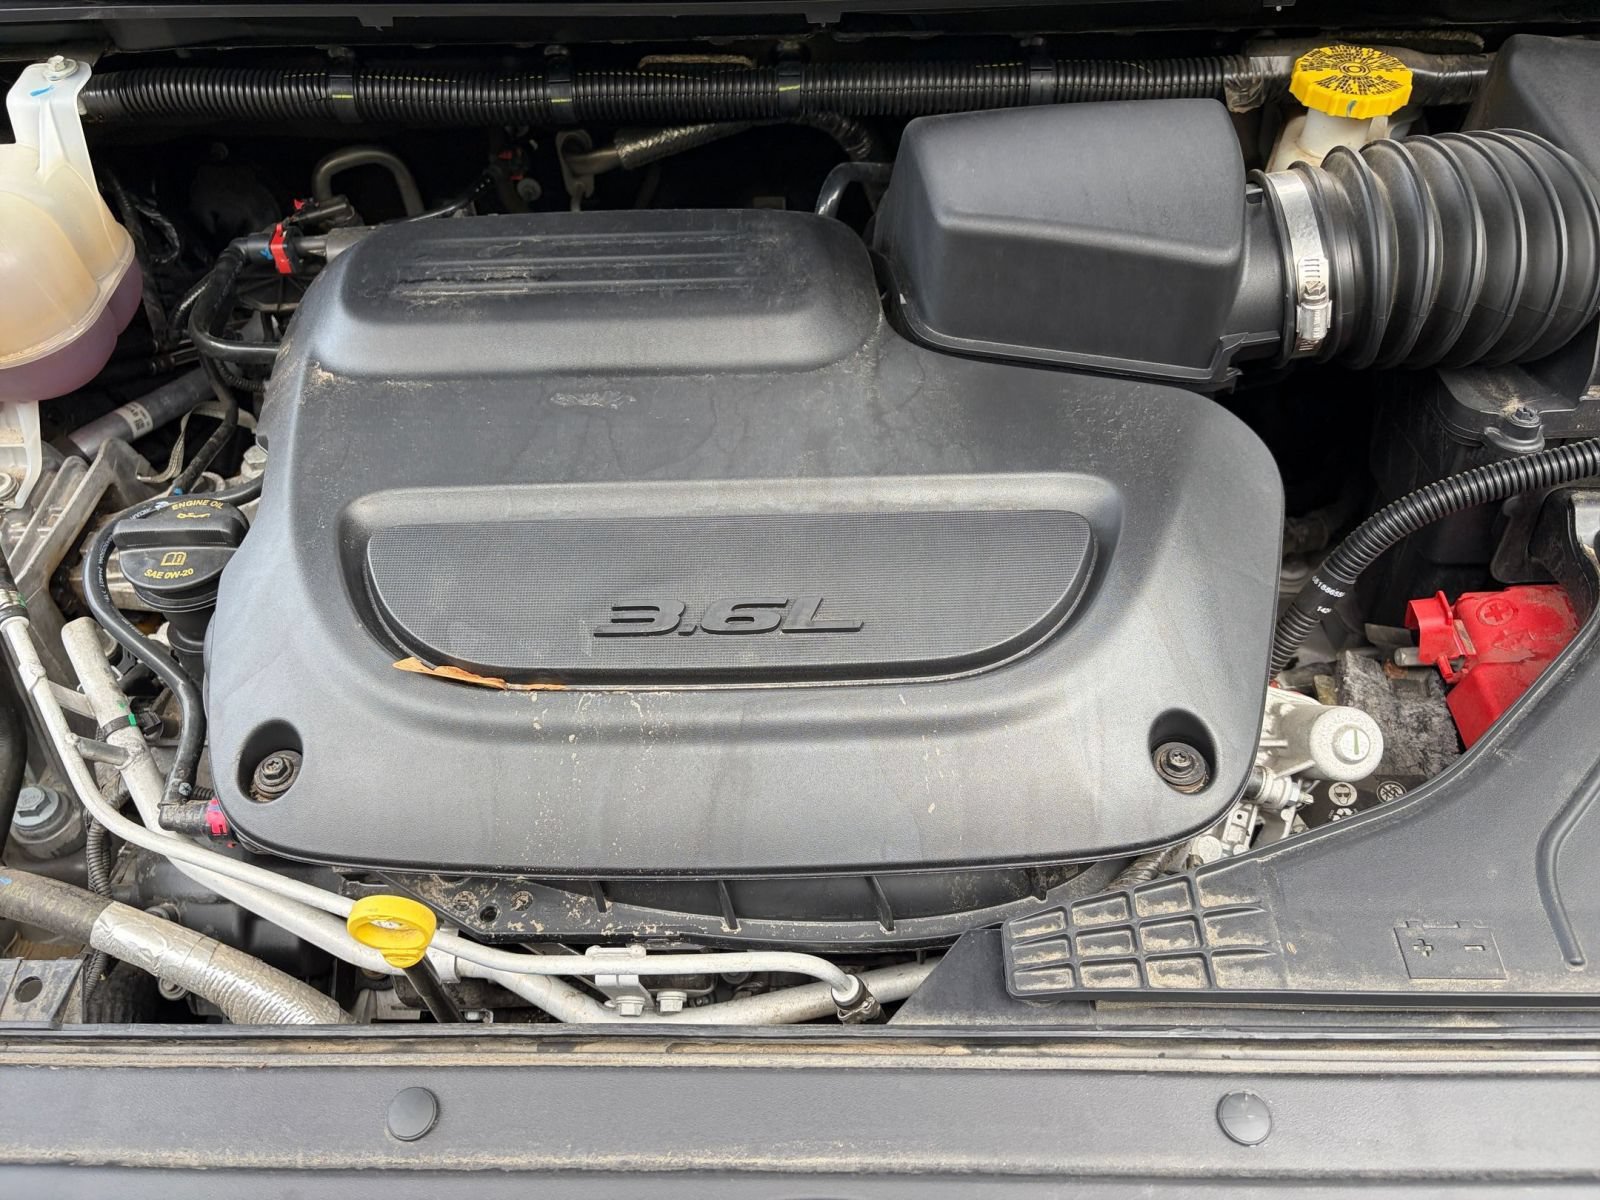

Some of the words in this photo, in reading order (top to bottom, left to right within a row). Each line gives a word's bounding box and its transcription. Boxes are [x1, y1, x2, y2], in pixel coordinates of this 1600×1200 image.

[171, 499, 209, 511] ENGINE
[210, 500, 224, 510] OIL
[144, 568, 163, 579] SAE
[164, 568, 194, 579] 0W-20
[593, 597, 865, 637] 3.6L
